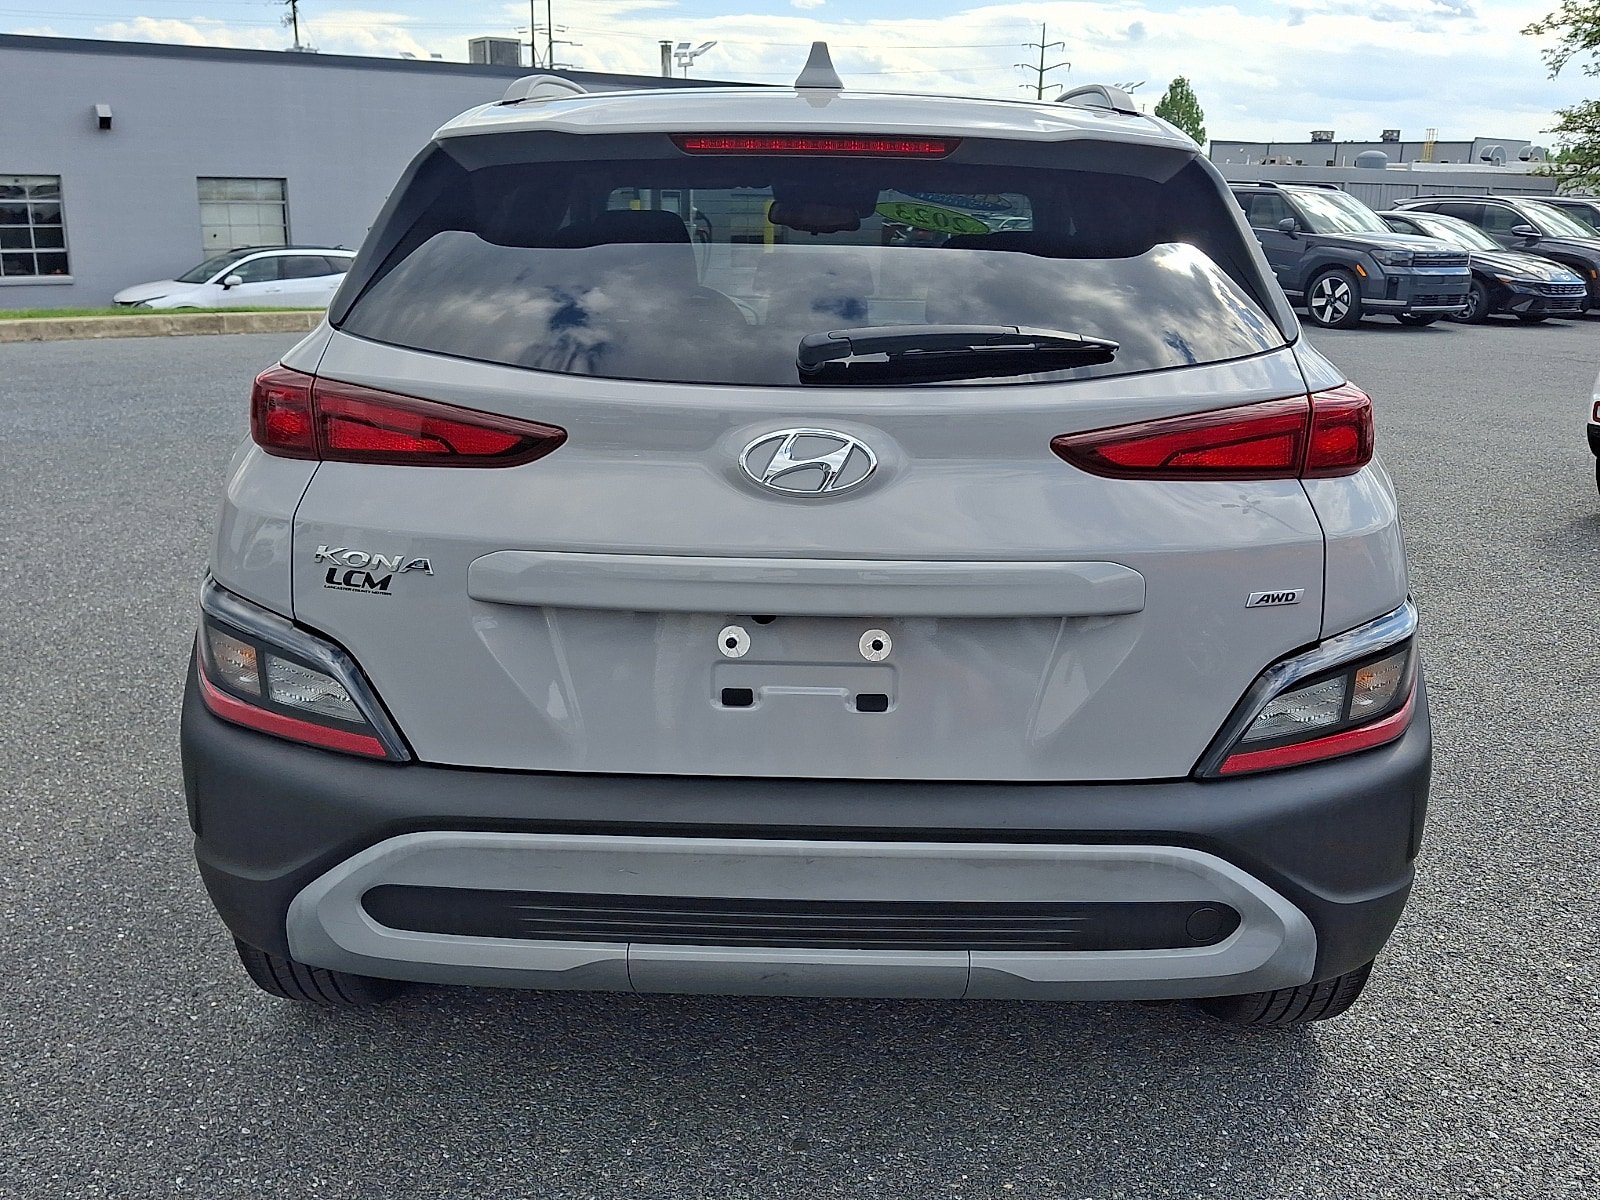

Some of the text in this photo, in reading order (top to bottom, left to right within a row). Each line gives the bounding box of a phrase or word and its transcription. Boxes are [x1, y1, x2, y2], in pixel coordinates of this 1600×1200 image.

[314, 544, 434, 576] KONA
[325, 567, 393, 591] LCM
[1254, 592, 1296, 605] AWD
